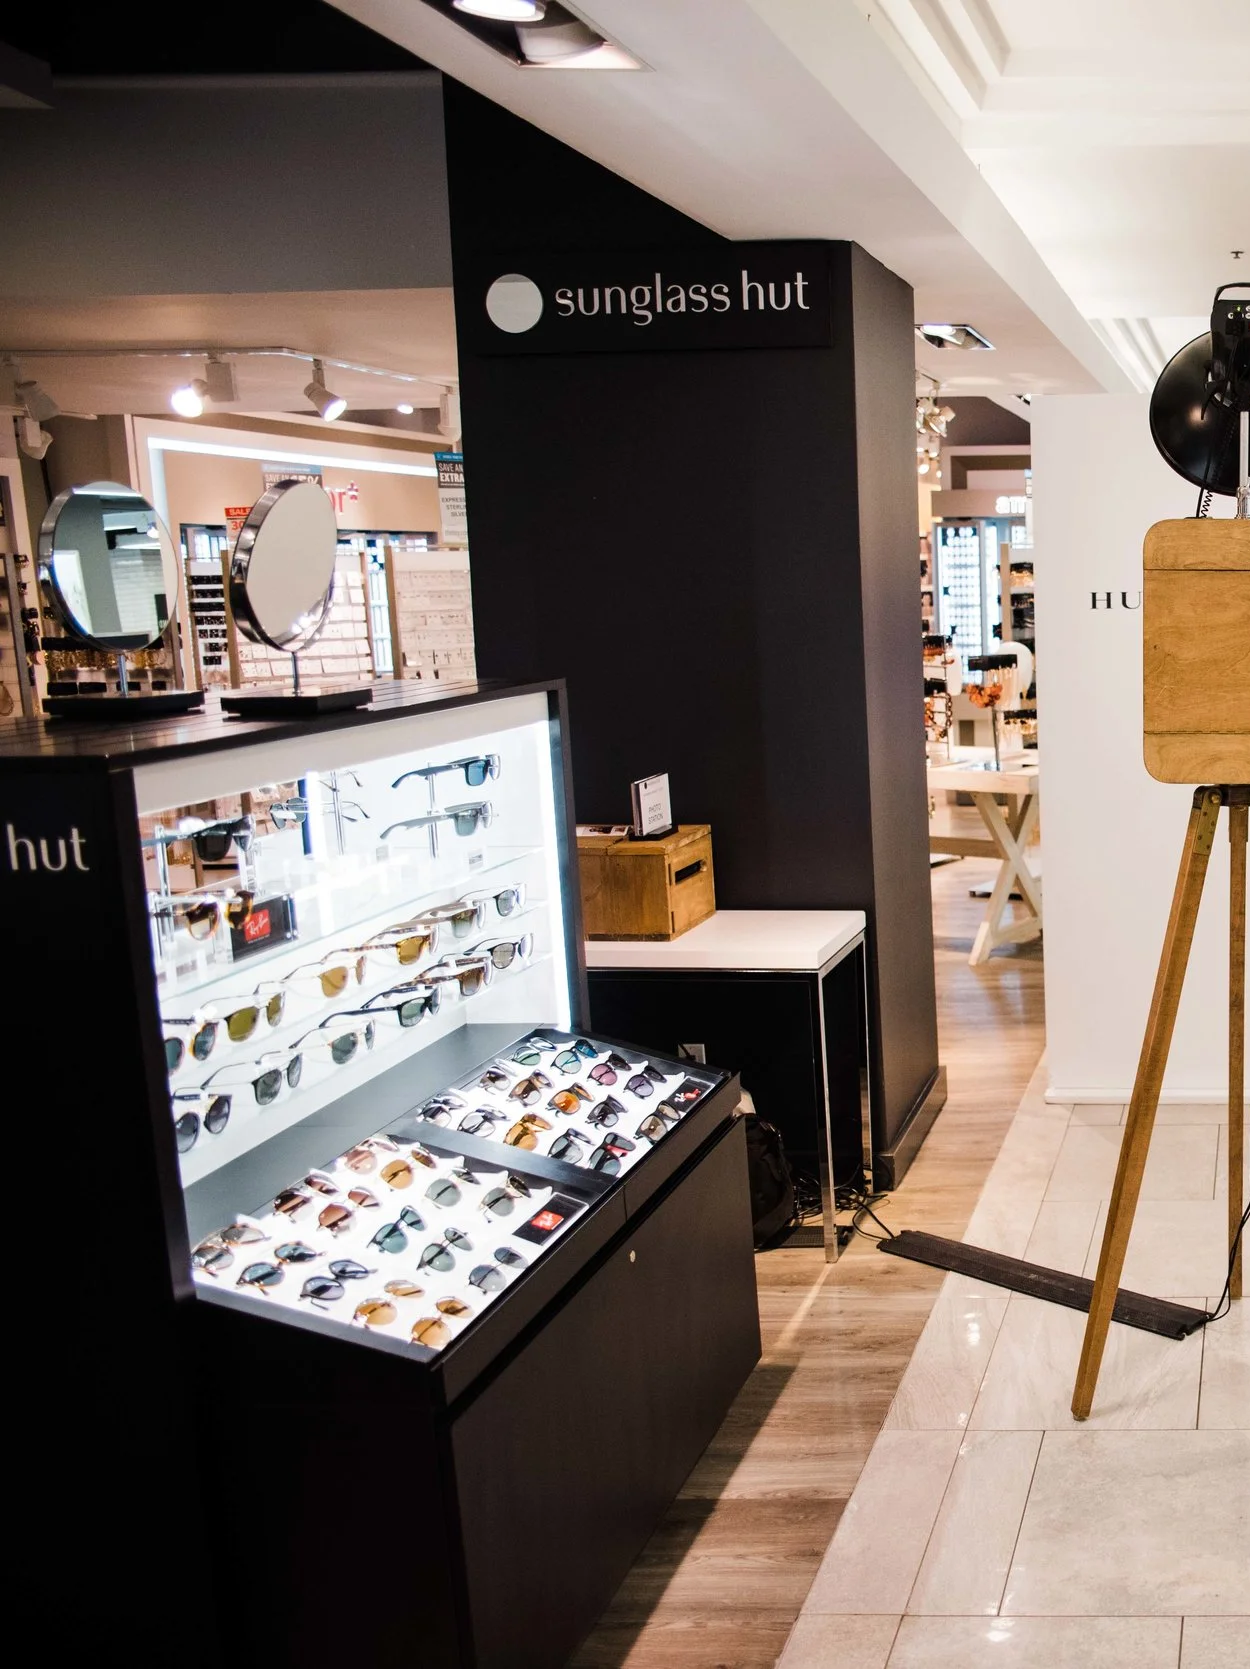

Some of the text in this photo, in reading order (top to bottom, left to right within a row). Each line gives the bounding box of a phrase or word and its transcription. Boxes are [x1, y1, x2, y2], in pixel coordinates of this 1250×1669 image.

[555, 270, 810, 327] sunglass hut
[438, 463, 454, 473] SAVE
[7, 823, 90, 871] hut
